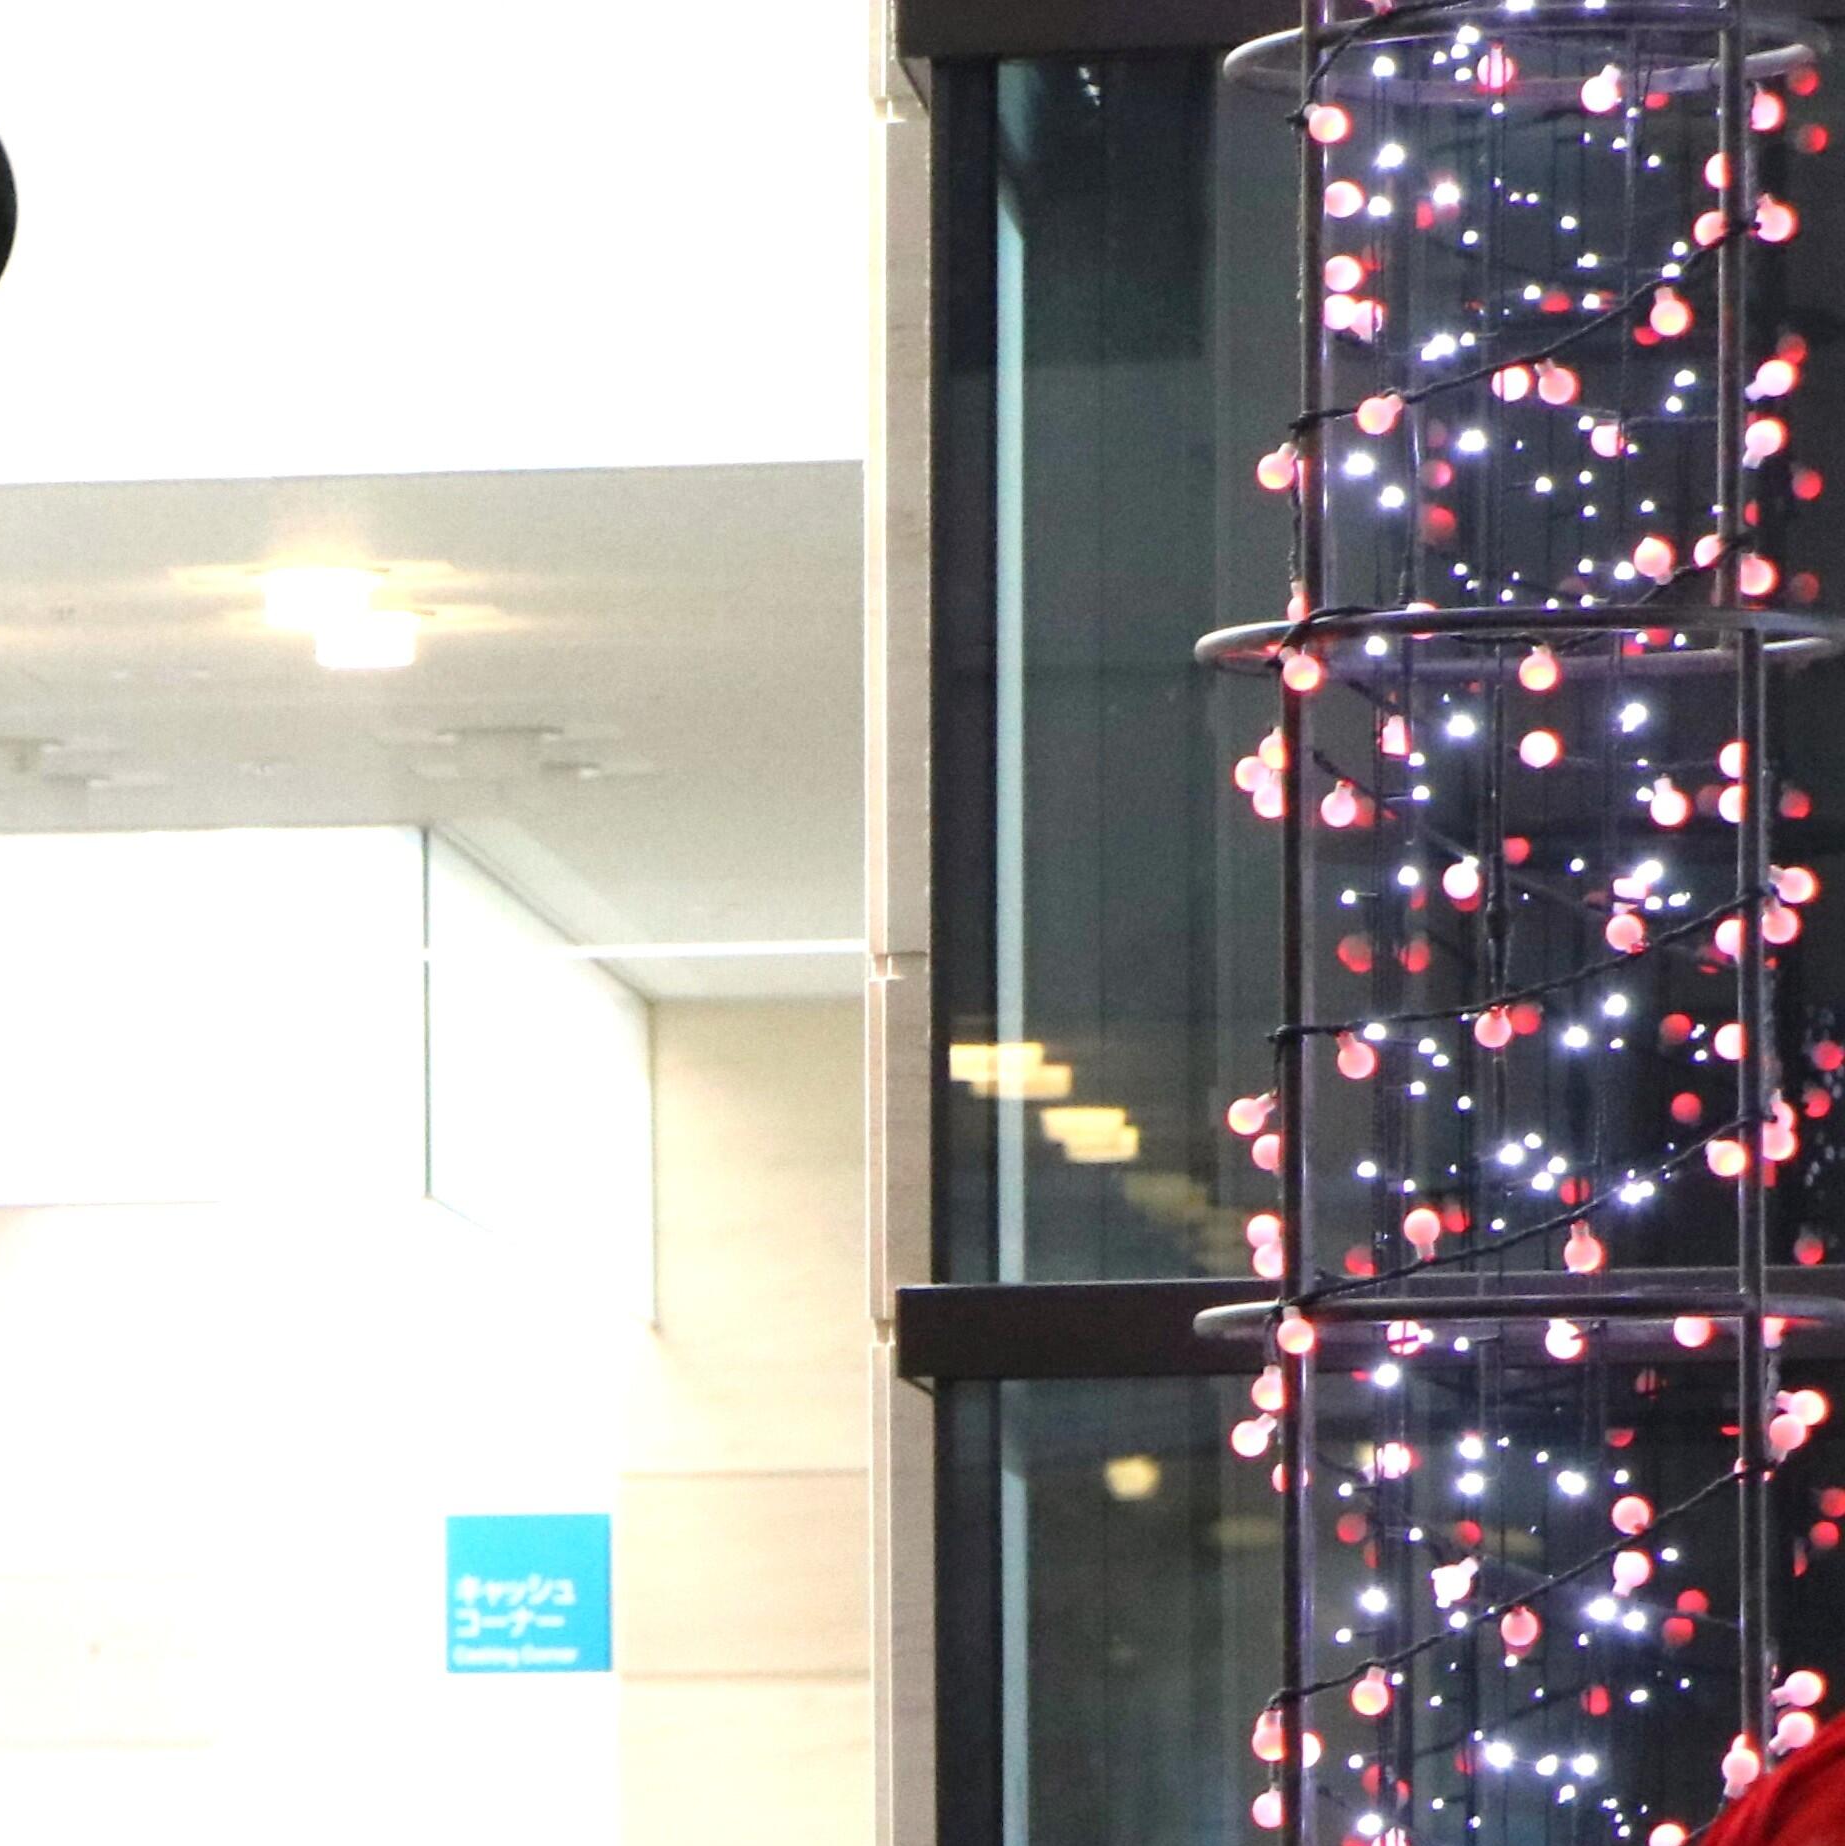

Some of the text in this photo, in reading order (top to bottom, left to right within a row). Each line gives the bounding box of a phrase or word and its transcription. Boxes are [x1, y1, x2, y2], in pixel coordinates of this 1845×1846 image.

[454, 1573, 576, 1606] キャッシュ
[455, 1606, 565, 1638] コーナー
